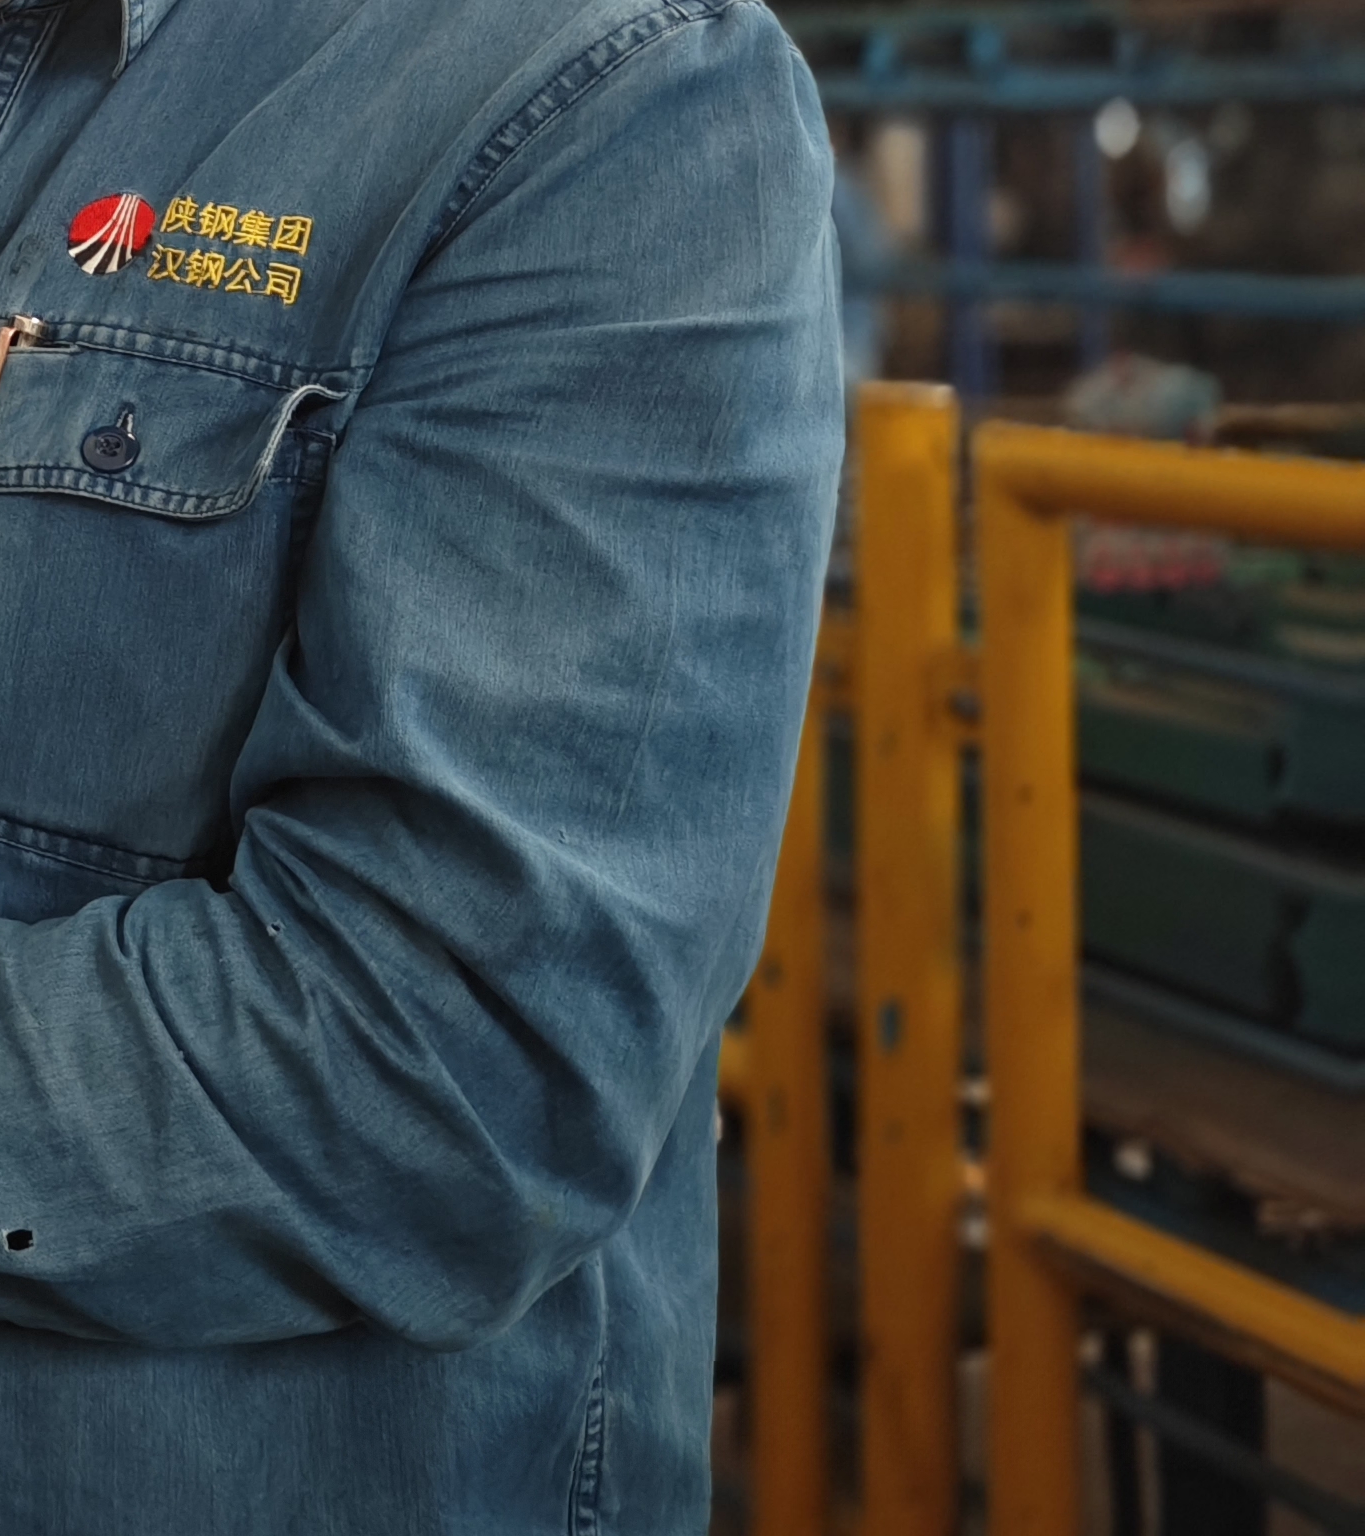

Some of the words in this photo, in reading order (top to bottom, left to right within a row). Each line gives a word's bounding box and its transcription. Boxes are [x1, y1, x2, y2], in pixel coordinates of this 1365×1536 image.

[160, 195, 313, 256] 陕钢集团
[146, 243, 302, 305] 汉钢公司
